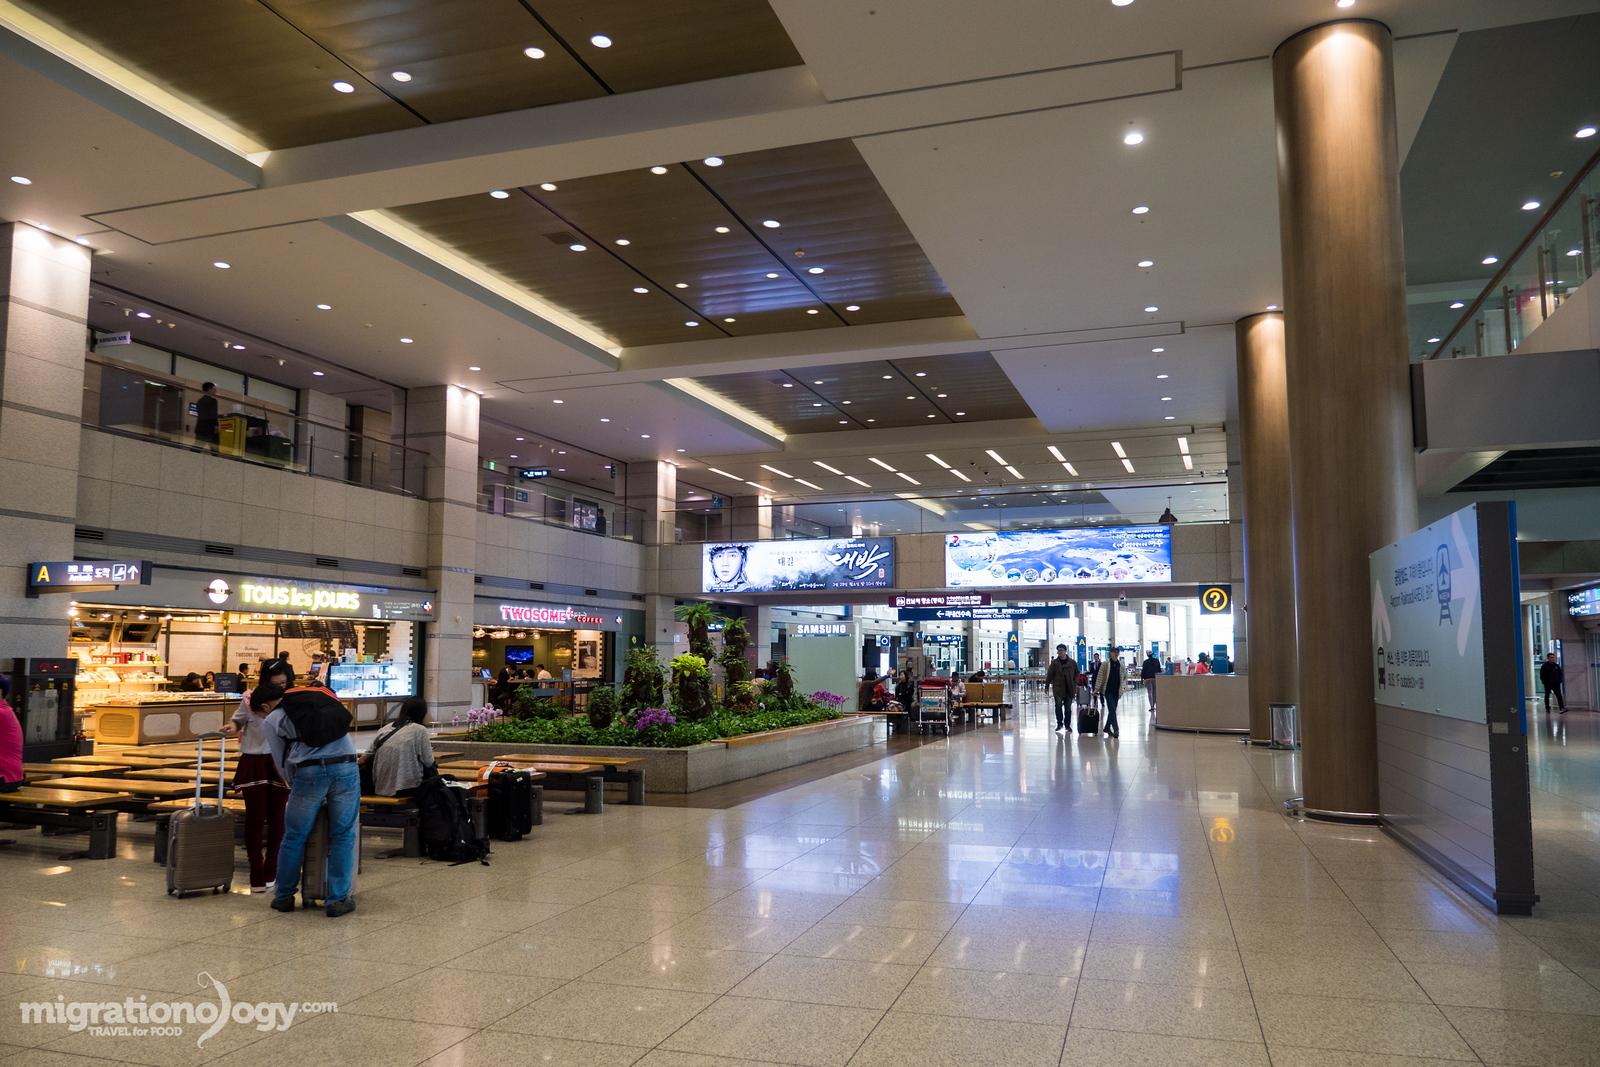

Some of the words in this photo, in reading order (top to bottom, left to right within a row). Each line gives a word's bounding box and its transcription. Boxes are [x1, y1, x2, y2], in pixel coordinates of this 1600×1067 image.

[713, 495, 719, 504] 2
[825, 544, 890, 580] 대박
[36, 566, 50, 582] A
[68, 573, 94, 582] Arrivals
[94, 568, 110, 578] 도착
[240, 584, 290, 606] TOUS
[290, 587, 313, 606] les
[310, 590, 360, 611] JOURS
[500, 605, 567, 624] TWOSOME
[797, 624, 847, 634] SAMSUNG
[1010, 634, 1018, 642] A
